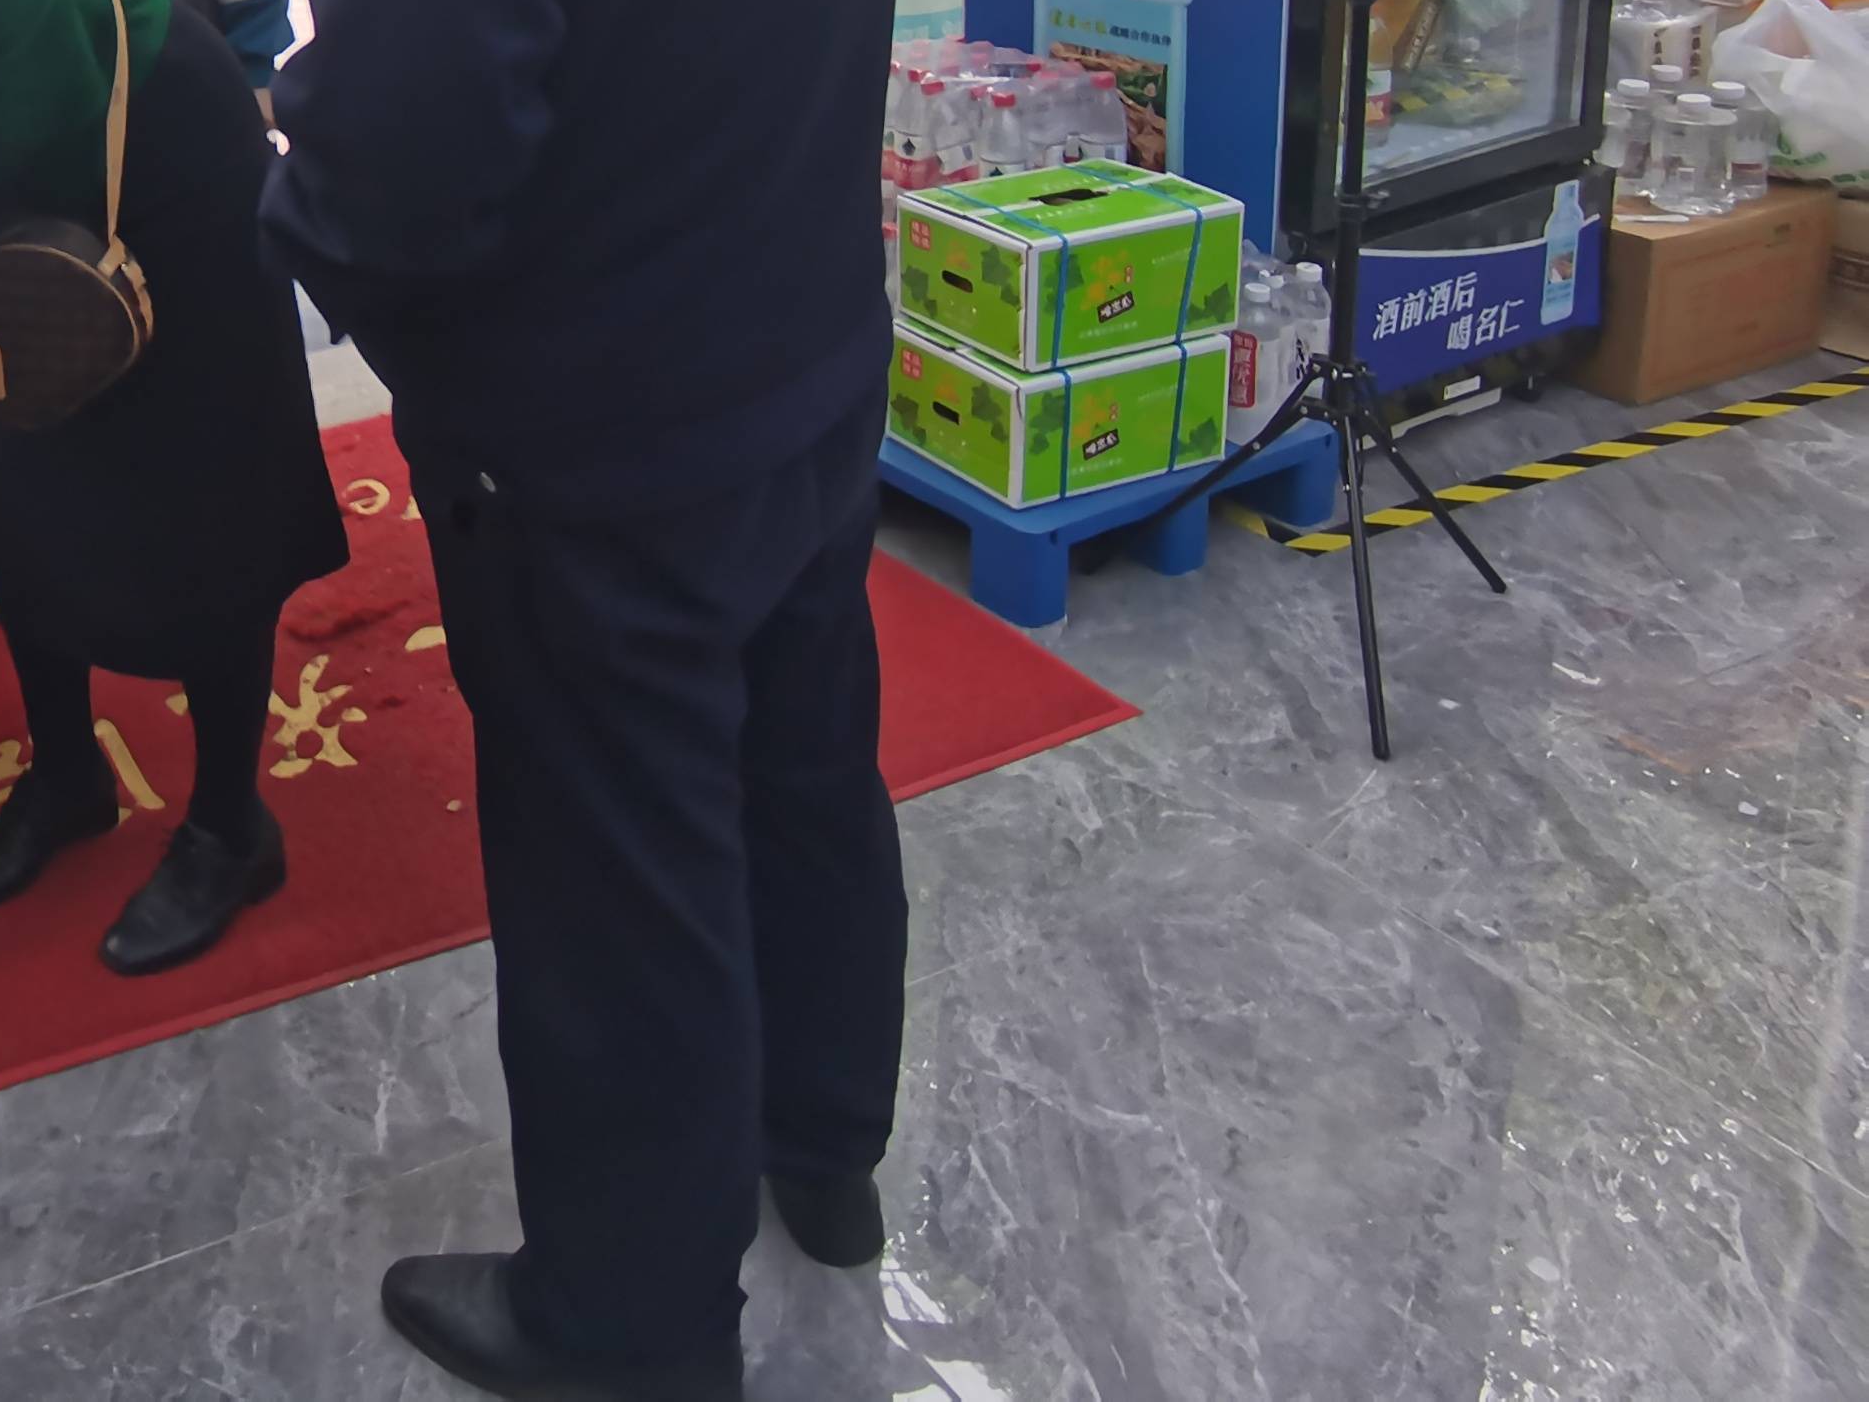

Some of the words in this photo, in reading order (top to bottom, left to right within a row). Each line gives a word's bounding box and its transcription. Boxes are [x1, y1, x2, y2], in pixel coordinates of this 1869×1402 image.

[1372, 271, 1479, 341] 酒前酒后
[1446, 298, 1525, 350] 喝名仁
